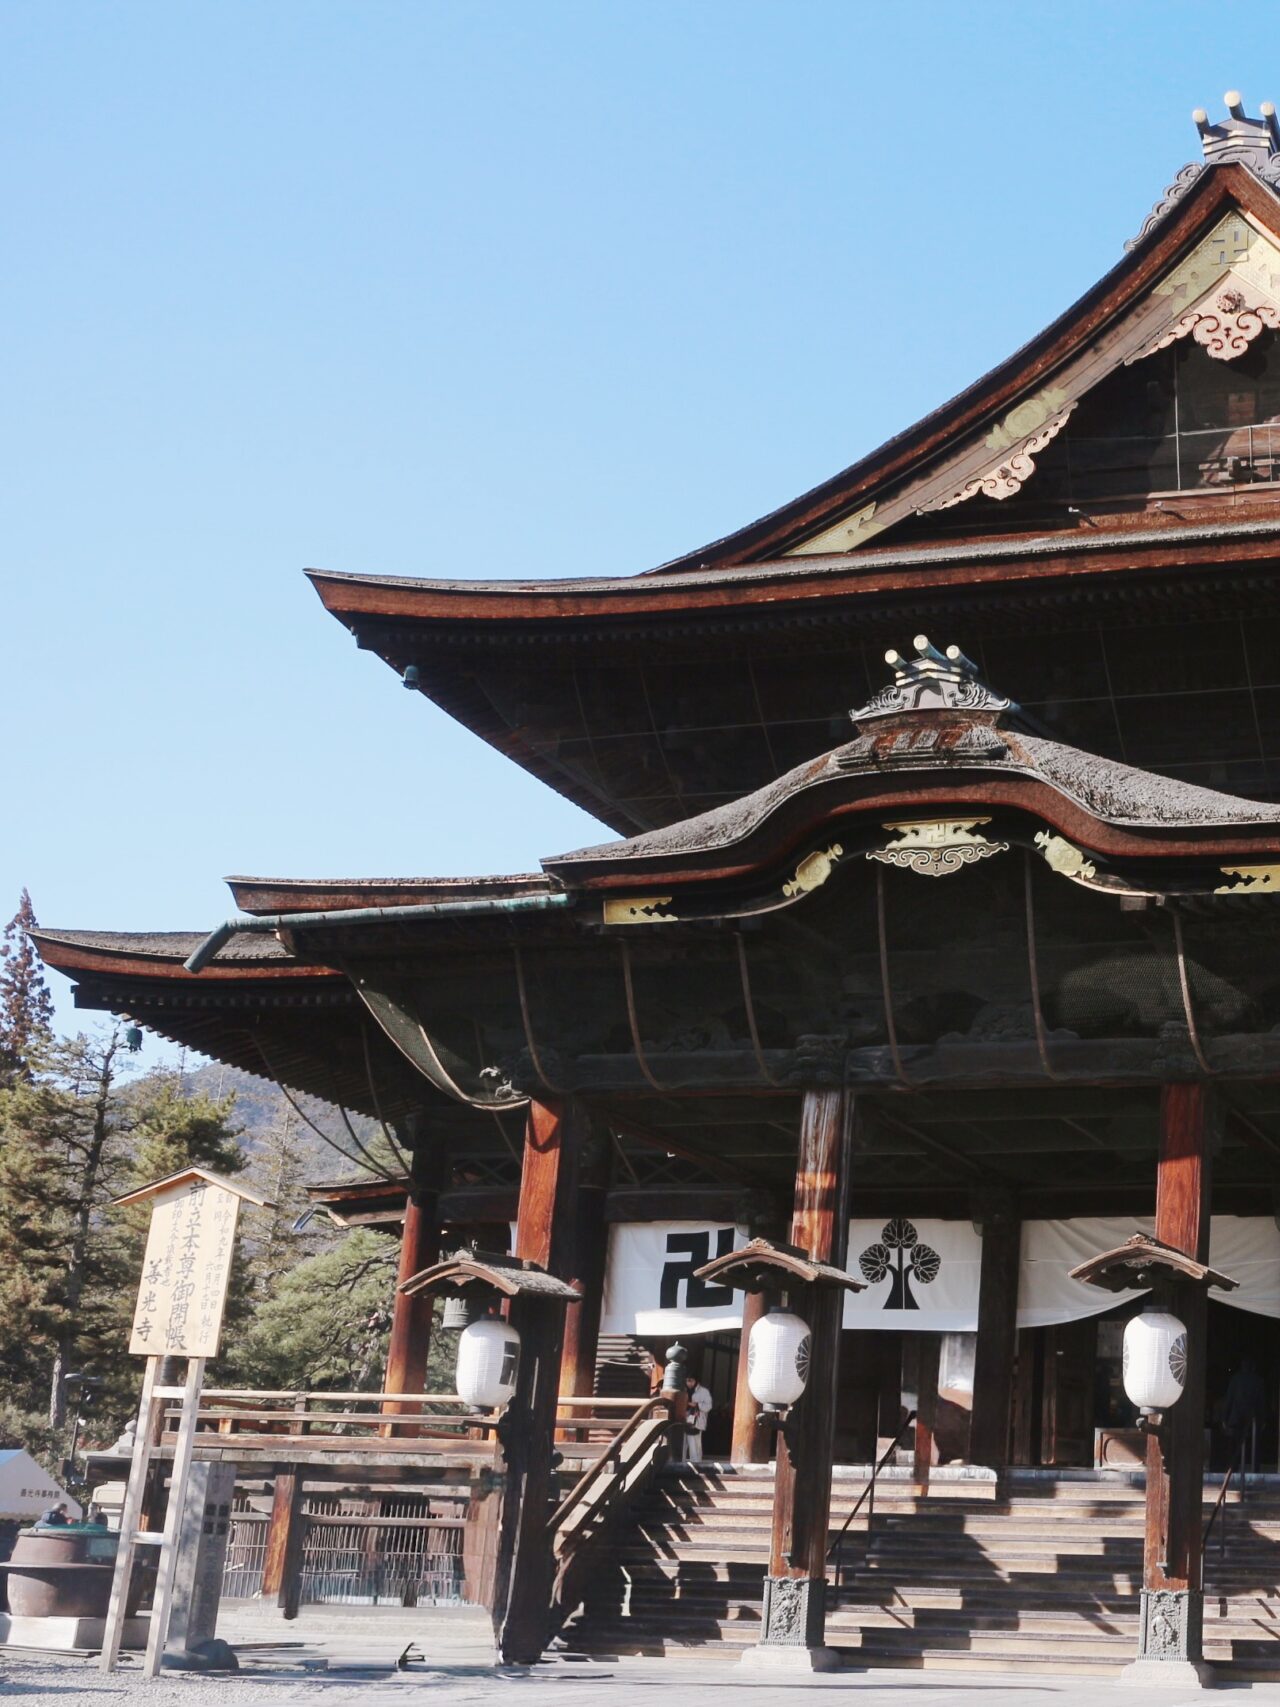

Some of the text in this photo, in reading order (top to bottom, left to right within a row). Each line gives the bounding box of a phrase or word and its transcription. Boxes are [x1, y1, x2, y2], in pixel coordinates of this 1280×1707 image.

[135, 1258, 163, 1342] 善光寺
[165, 1181, 208, 1350] 前立本尊御開帳
